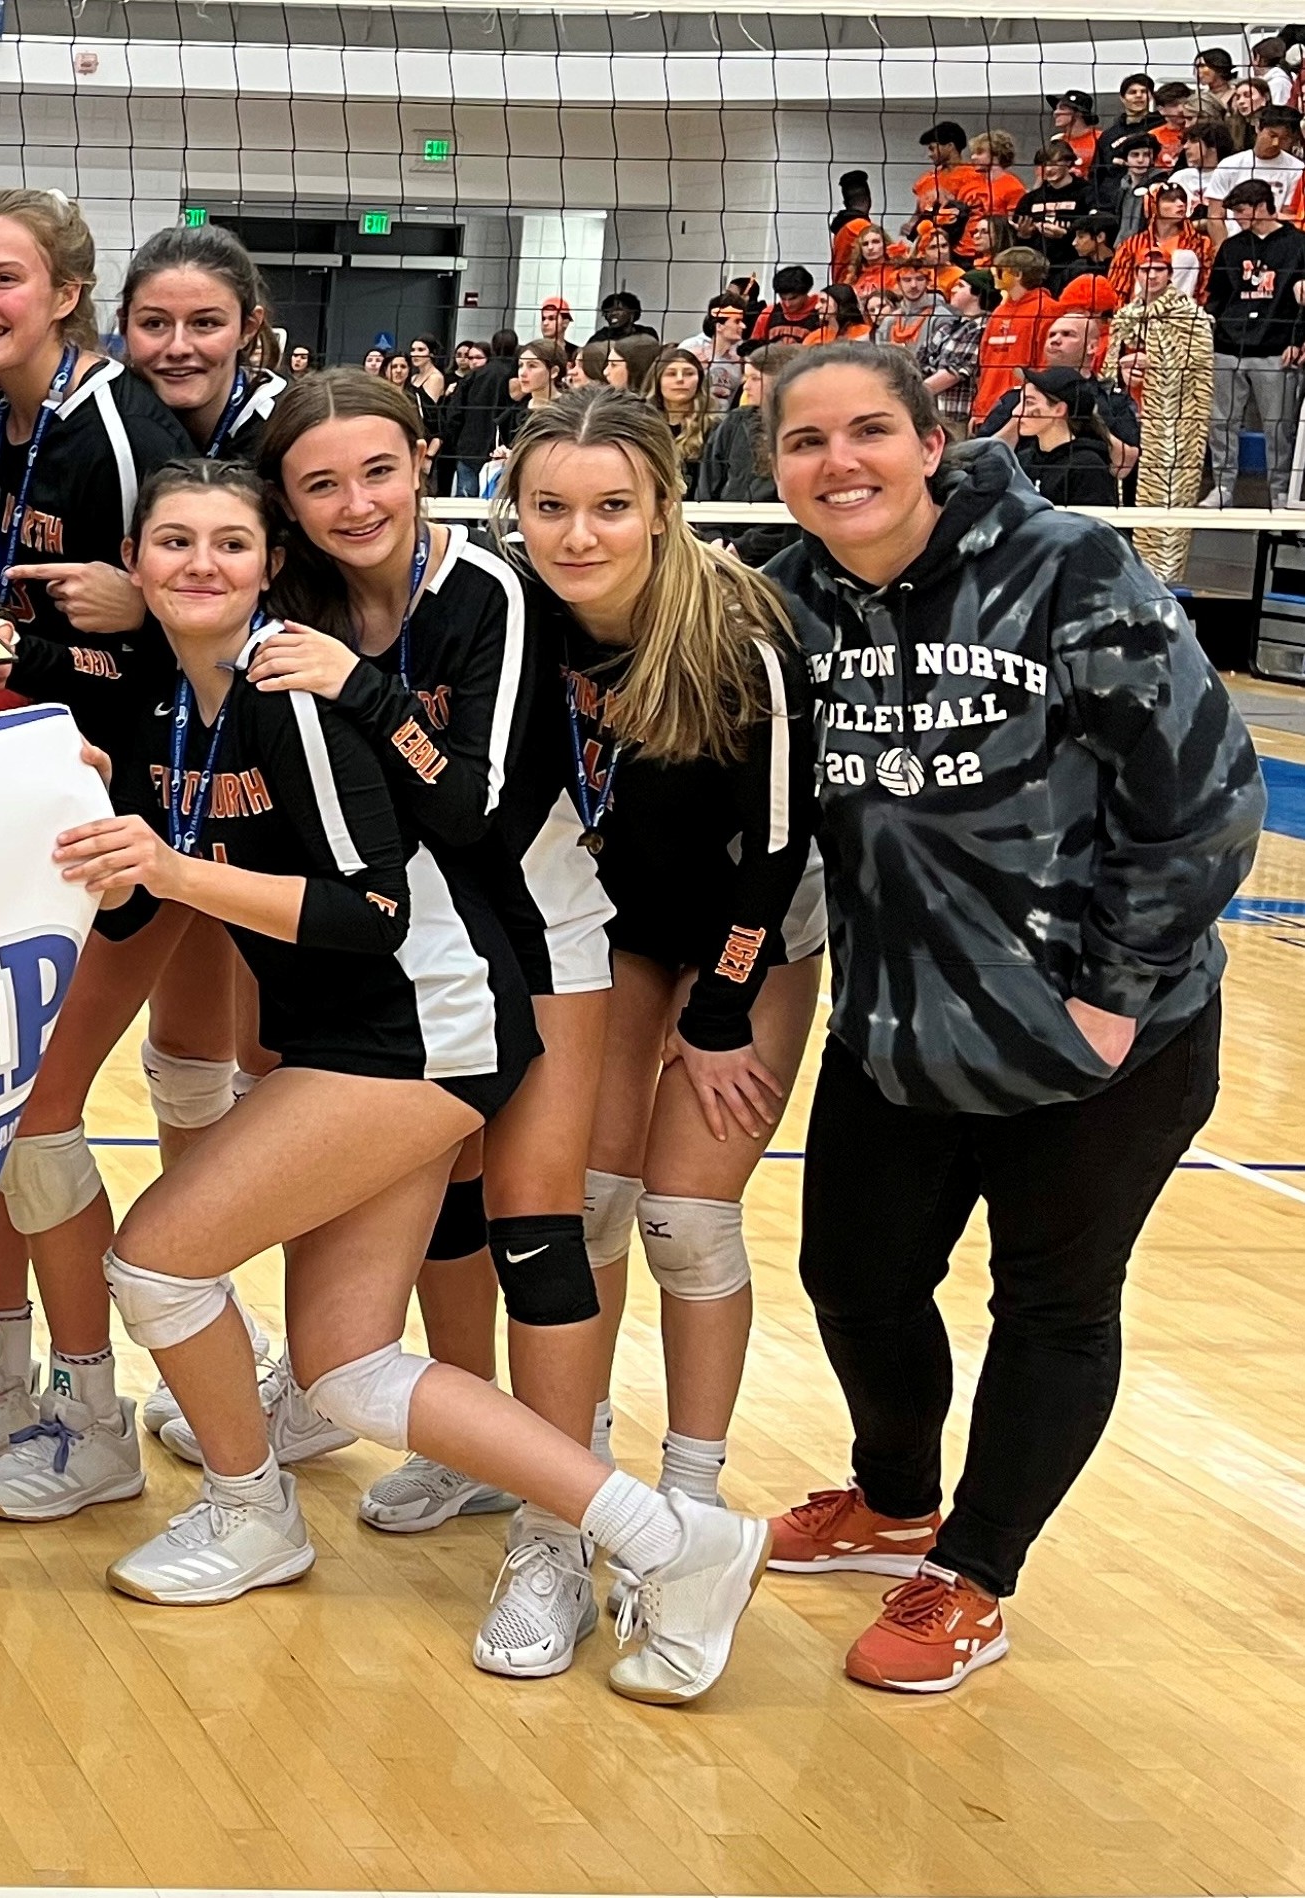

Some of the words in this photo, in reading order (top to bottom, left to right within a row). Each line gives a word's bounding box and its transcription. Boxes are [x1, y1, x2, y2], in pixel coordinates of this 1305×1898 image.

[366, 213, 389, 234] EXIT
[915, 642, 1047, 696] NORTH
[391, 716, 448, 785] TIGER
[826, 752, 866, 786] 20
[932, 751, 984, 787] 22
[715, 924, 767, 984] TIGER
